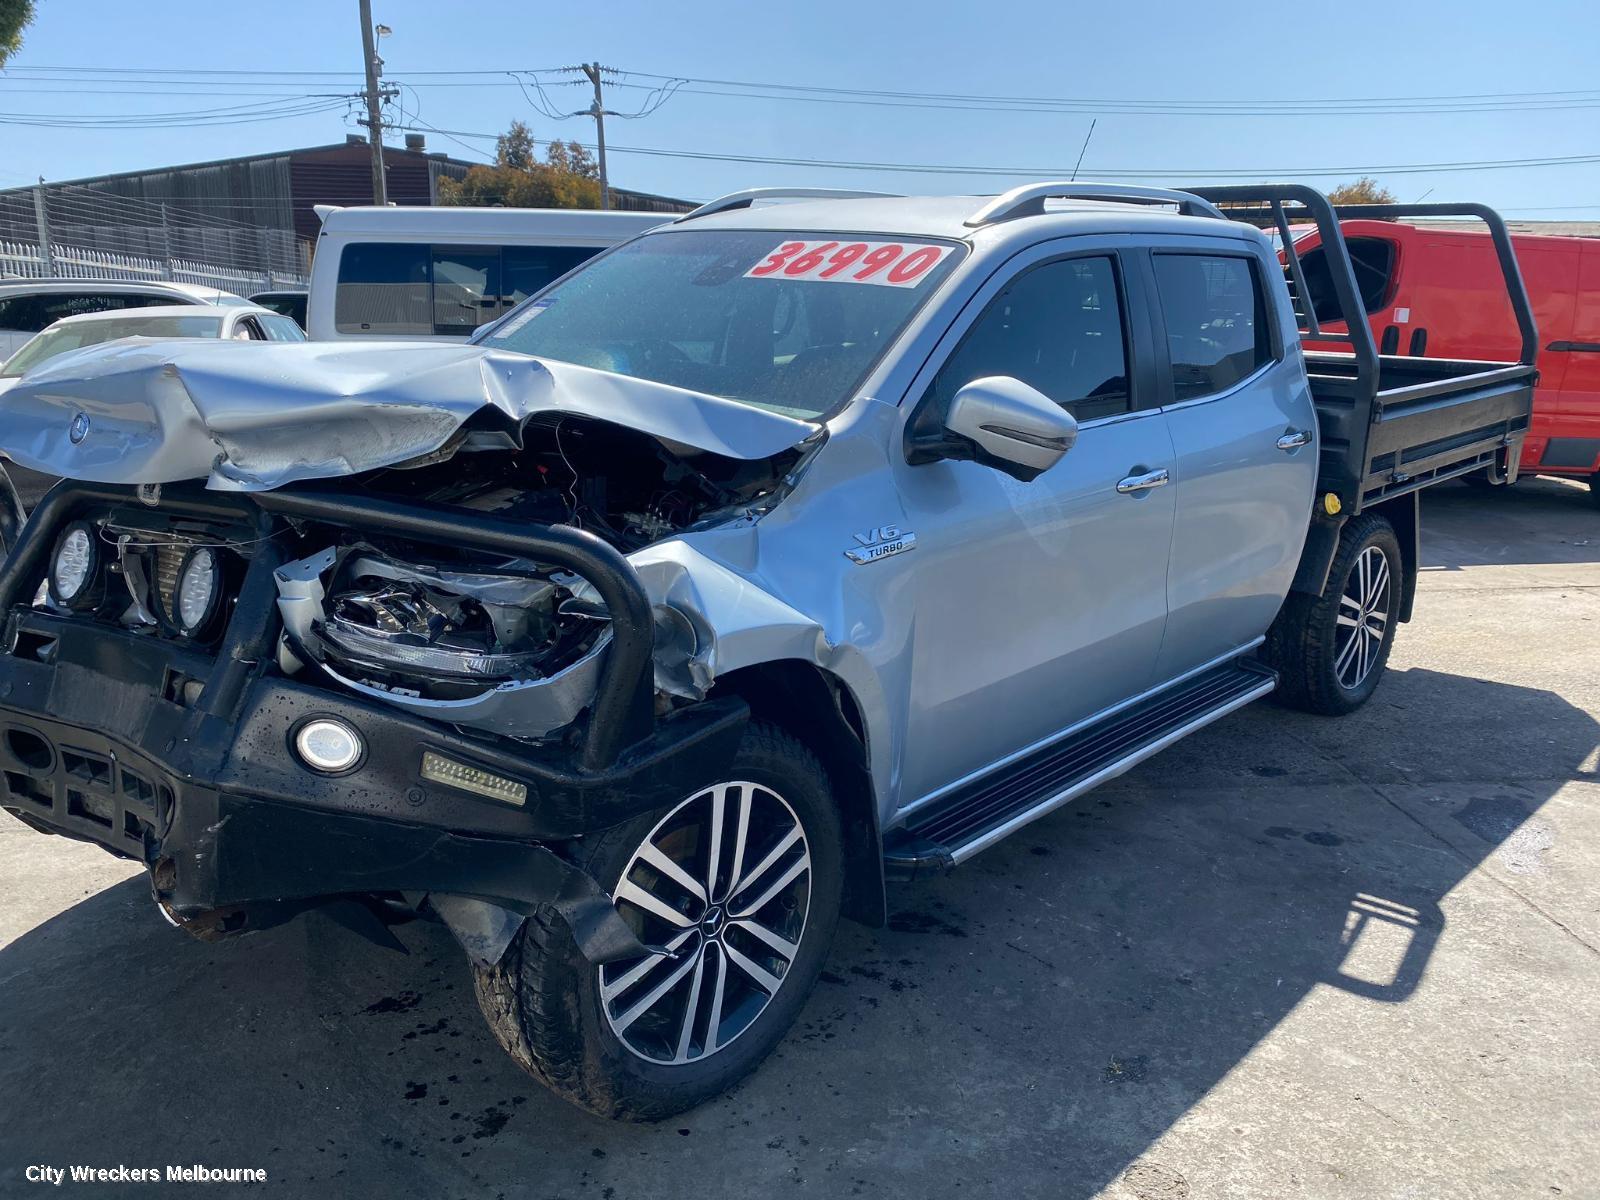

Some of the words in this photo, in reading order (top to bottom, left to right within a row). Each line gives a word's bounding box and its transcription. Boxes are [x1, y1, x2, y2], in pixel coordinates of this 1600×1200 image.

[751, 242, 942, 283] 36990
[853, 524, 901, 546] V6
[868, 541, 903, 558] TURBO
